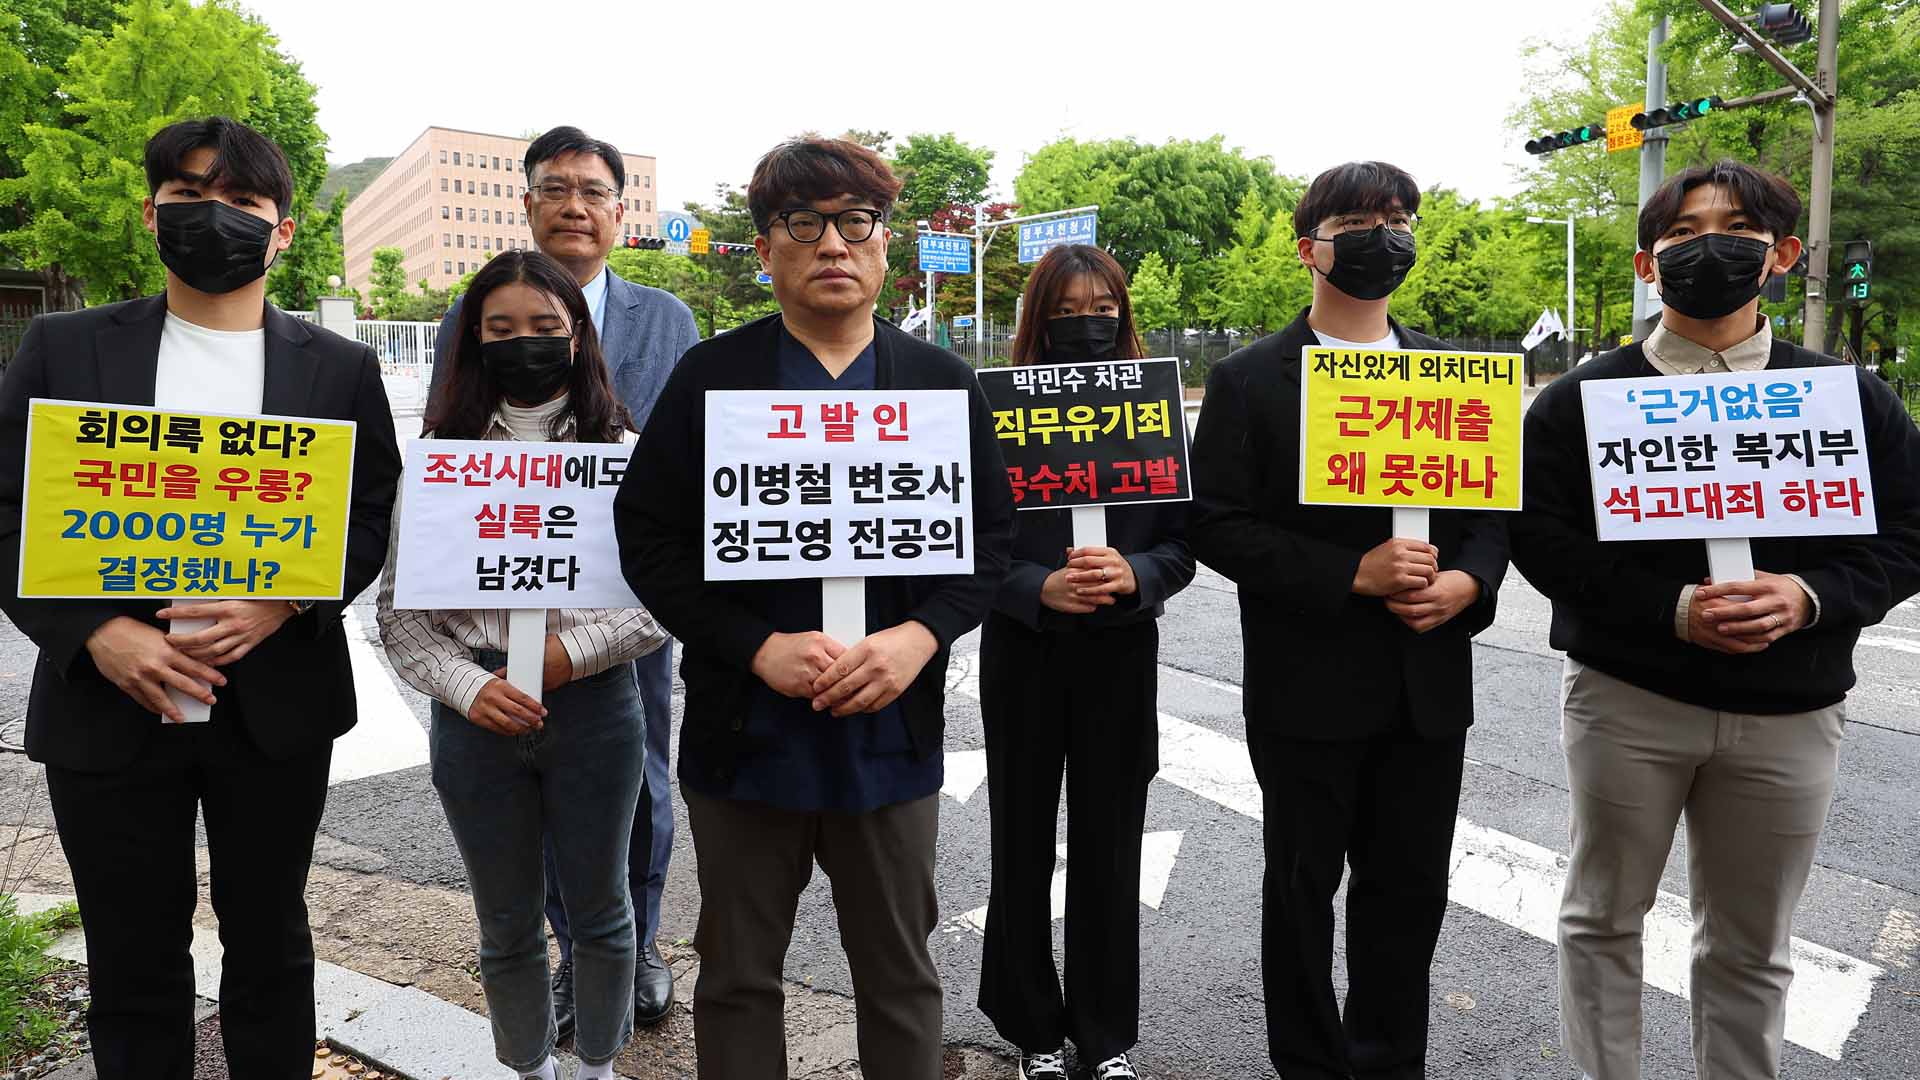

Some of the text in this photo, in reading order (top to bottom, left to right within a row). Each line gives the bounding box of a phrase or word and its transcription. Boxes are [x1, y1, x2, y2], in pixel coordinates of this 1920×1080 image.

[1853, 283, 1867, 298] 13
[1013, 364, 1143, 395] 박민수 차관
[1314, 352, 1513, 385] 자신있게 외치더니
[76, 410, 315, 458] 회의록 없다?
[992, 400, 1171, 446] 직무유기죄
[1335, 396, 1493, 442] 근거제출
[424, 453, 628, 489] 조선시대에도
[1599, 430, 1858, 474] 자인한 복지부
[74, 459, 312, 503] 국민을 우롱?
[713, 462, 964, 506] 이병철 변호사
[1111, 456, 1179, 494] 고발
[1328, 452, 1497, 498] 왜 못하나
[1604, 478, 1864, 522] 석고대죄 하라
[61, 510, 317, 549] 2000명 누가
[475, 504, 577, 539] 실록은
[712, 517, 963, 563] 정근영 전공의
[98, 556, 281, 592] 결정했나?
[477, 555, 580, 591] 남겼다
